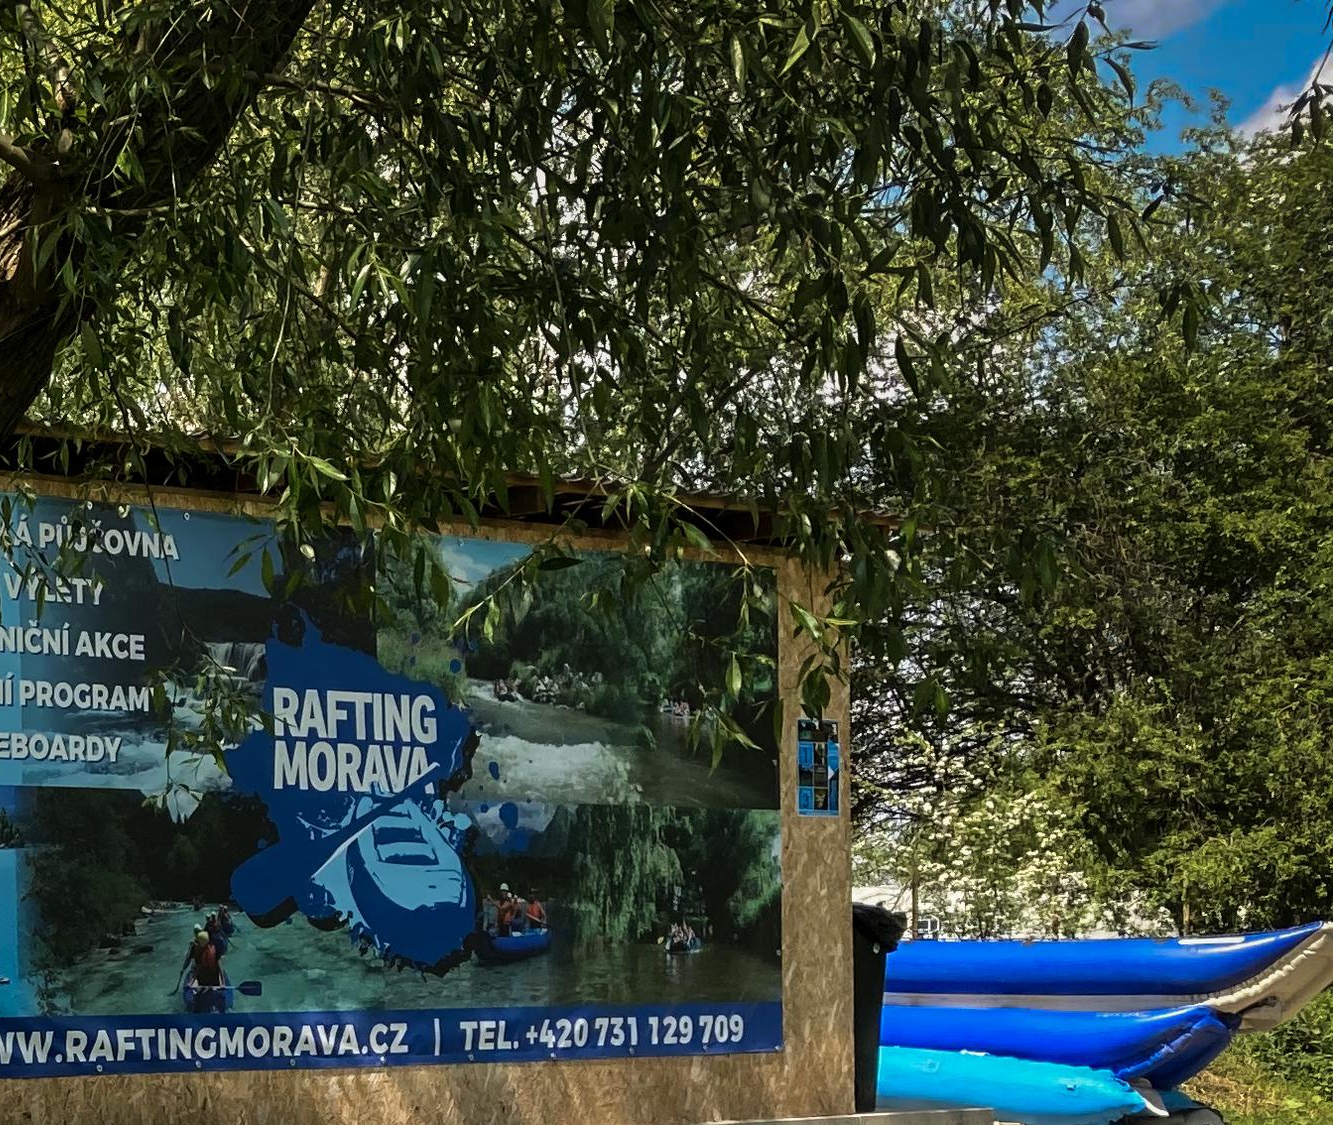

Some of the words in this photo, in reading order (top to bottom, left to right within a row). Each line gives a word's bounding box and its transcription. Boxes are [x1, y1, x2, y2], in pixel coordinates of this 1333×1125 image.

[74, 631, 145, 660] AKCE
[19, 680, 154, 712] PROGRAM
[273, 687, 437, 744] RAFTING
[274, 740, 436, 794] MORAVA
[460, 1020, 519, 1051] TEL.
[526, 1017, 588, 1048] +420
[596, 1016, 638, 1046] 731
[648, 1015, 693, 1045] 129
[700, 1014, 744, 1043] 709
